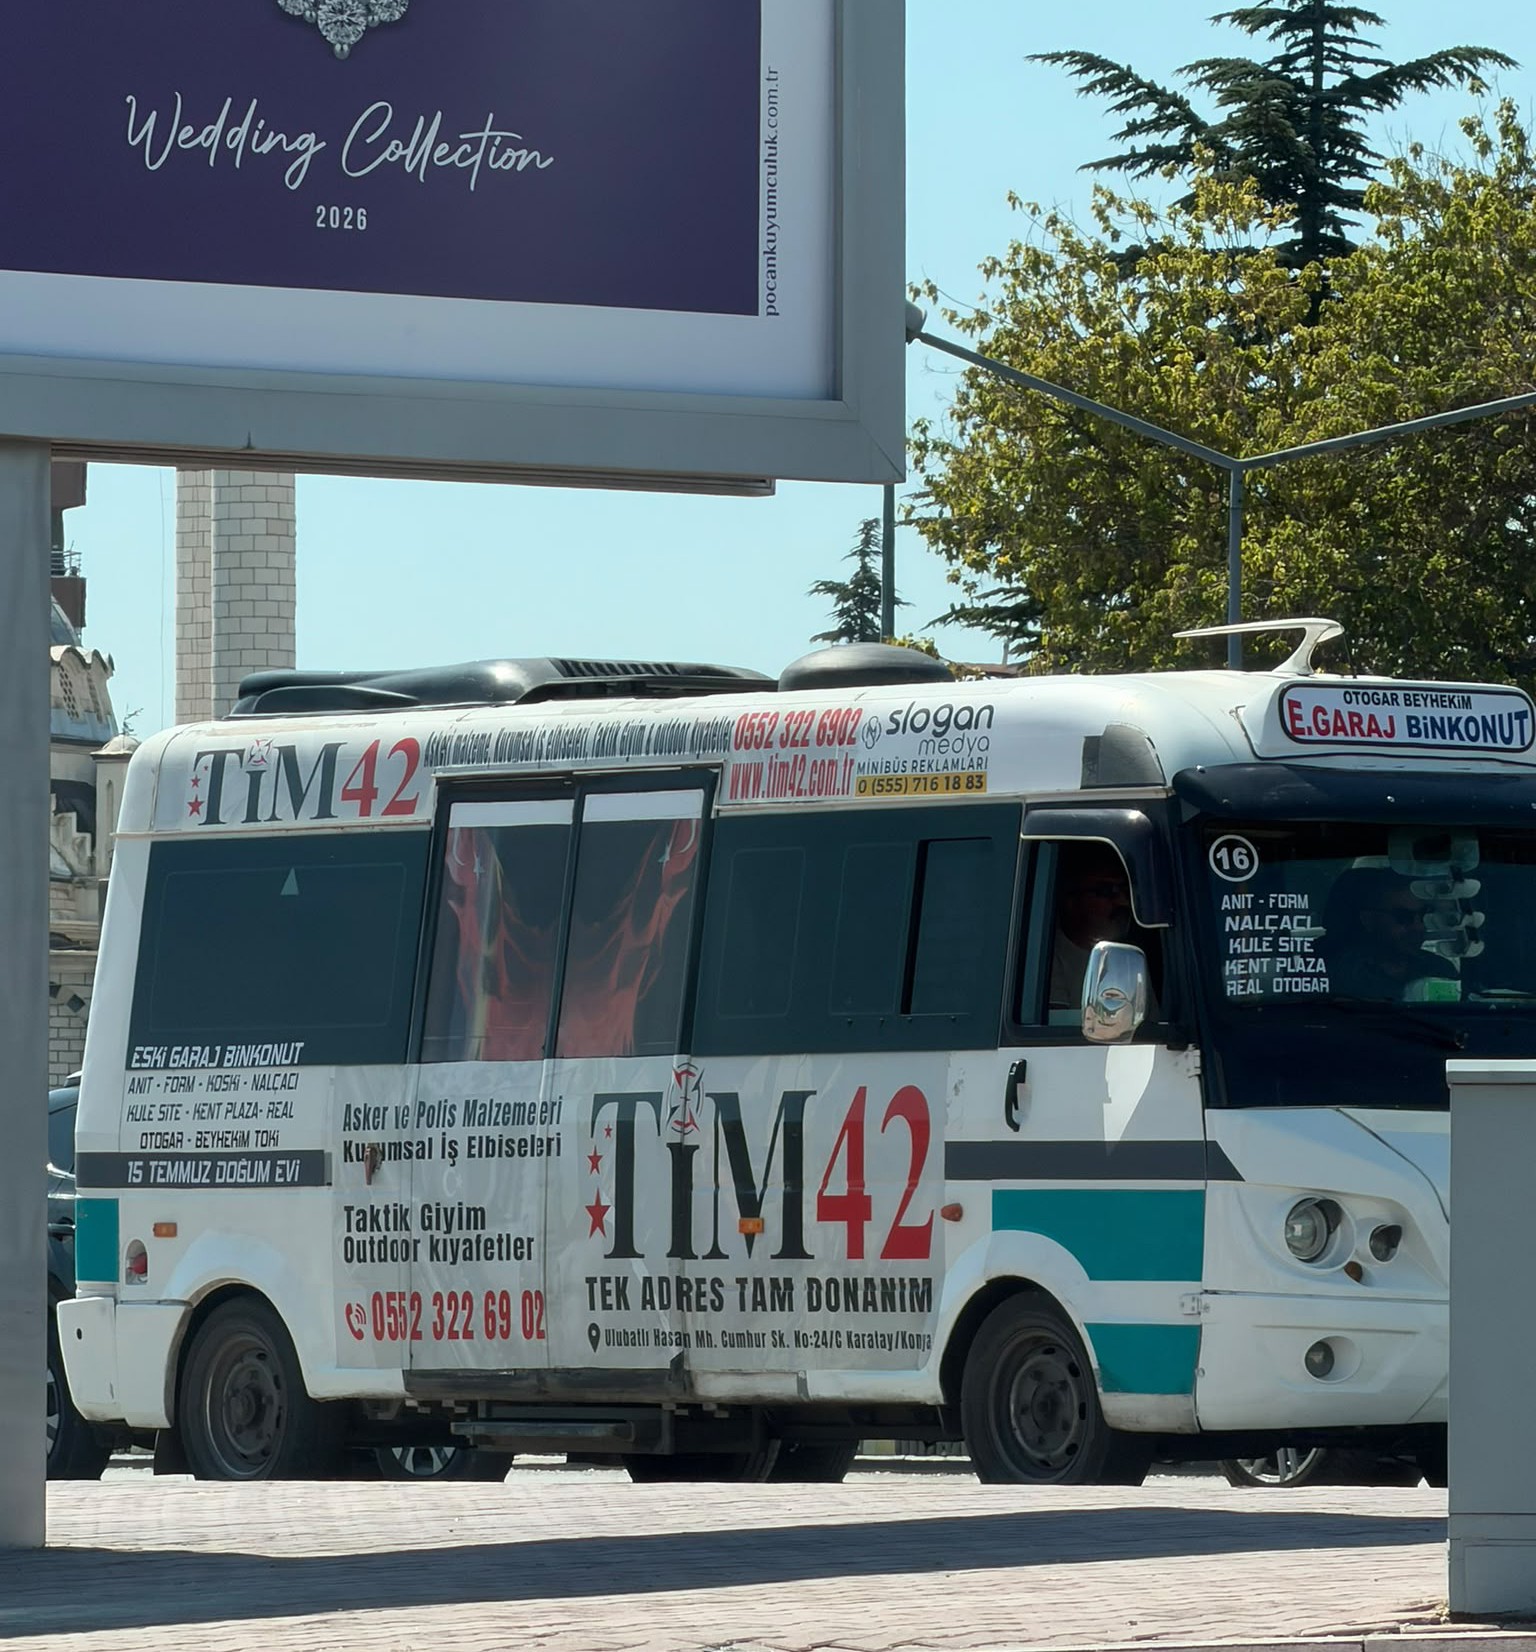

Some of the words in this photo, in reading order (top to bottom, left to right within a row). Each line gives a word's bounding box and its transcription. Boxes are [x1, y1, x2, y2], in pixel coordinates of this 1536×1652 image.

[126, 92, 326, 190] Wedding
[342, 101, 554, 191] Collection
[763, 66, 780, 317] pocankuyumculuk.com.tr
[316, 205, 368, 231] 2026
[1343, 690, 1400, 707] OTOGAR
[734, 711, 780, 751] 0552
[779, 709, 817, 749] 322
[816, 707, 863, 748] 6902
[886, 701, 994, 738] slogan
[1287, 698, 1396, 740] E.GARAJ
[918, 733, 990, 757] medya
[729, 752, 855, 800] www.tim42.com.tr
[857, 755, 908, 775] MİNİBÜS
[911, 756, 989, 773] REKLAMLARI
[857, 779, 868, 794] 0
[871, 777, 909, 796] (555)
[912, 776, 939, 792] 716
[944, 775, 961, 791] 18
[965, 774, 984, 790] 83
[1216, 847, 1250, 870] 16
[1221, 893, 1255, 911] ANIT
[1269, 893, 1309, 910] FORM
[1225, 914, 1313, 934] NALÇACI
[1229, 937, 1273, 955] KULE
[1225, 957, 1271, 976] KENT
[1276, 957, 1327, 973] PLAZA
[1226, 979, 1264, 997] REAL
[1272, 977, 1330, 994] OTOGAR
[168, 1045, 221, 1068] GARAJ
[127, 1076, 154, 1094] ANIT
[163, 1075, 196, 1093] FORM
[251, 1073, 300, 1095] NALÇACI
[126, 1104, 156, 1122] KULE
[192, 1103, 223, 1121] KENT
[266, 1101, 295, 1119] REAL
[343, 1102, 389, 1132] Asker
[394, 1105, 410, 1130] ve
[415, 1098, 457, 1129] Polis
[462, 1095, 564, 1128] Malzemeeri
[140, 1131, 184, 1150] OTOGAR
[343, 1136, 433, 1163] Kuumsal
[467, 1132, 562, 1159] Elbiseleri
[127, 1161, 144, 1183] 15
[149, 1160, 212, 1184] TEMMUZ
[215, 1158, 271, 1184] DOĞUM
[344, 1203, 411, 1233] Taktik
[420, 1202, 486, 1235] Giyim
[343, 1235, 421, 1264] Outdoor
[429, 1233, 535, 1266] kıyafetler
[585, 1276, 631, 1312] TEK
[641, 1276, 725, 1312] ADRES
[735, 1277, 795, 1313] TAM
[806, 1277, 934, 1313] DONANIM
[371, 1291, 423, 1341] 0552
[432, 1291, 474, 1341] 322
[484, 1290, 512, 1340] 69
[521, 1289, 546, 1340] 02
[605, 1328, 650, 1348] Ulubatlı
[653, 1328, 692, 1349] Hasan
[695, 1330, 717, 1349] Mh.
[721, 1329, 767, 1349] Cumhur
[771, 1330, 790, 1349] Sk.
